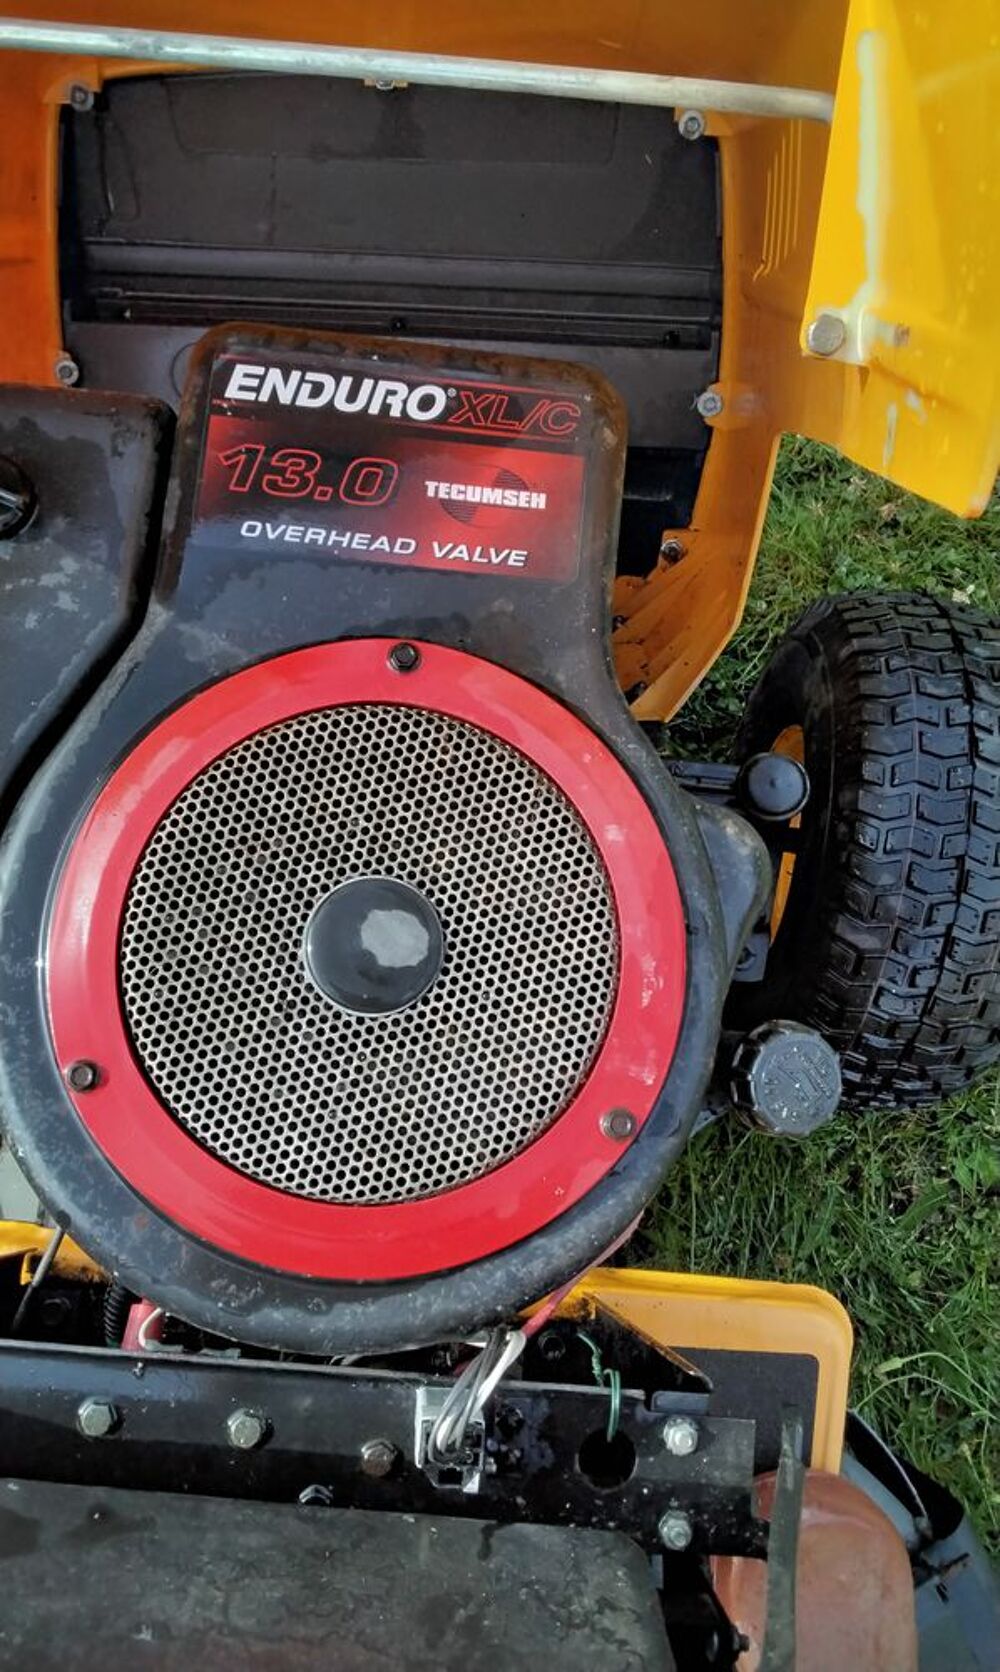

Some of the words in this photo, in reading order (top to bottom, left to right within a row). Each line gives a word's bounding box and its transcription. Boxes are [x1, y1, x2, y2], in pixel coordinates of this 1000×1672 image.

[449, 390, 582, 435] XL/C
[218, 443, 400, 507] 13.0
[425, 480, 547, 510] TECUMSEH
[240, 520, 417, 555] OVERHEAD
[432, 541, 528, 567] VALVE
